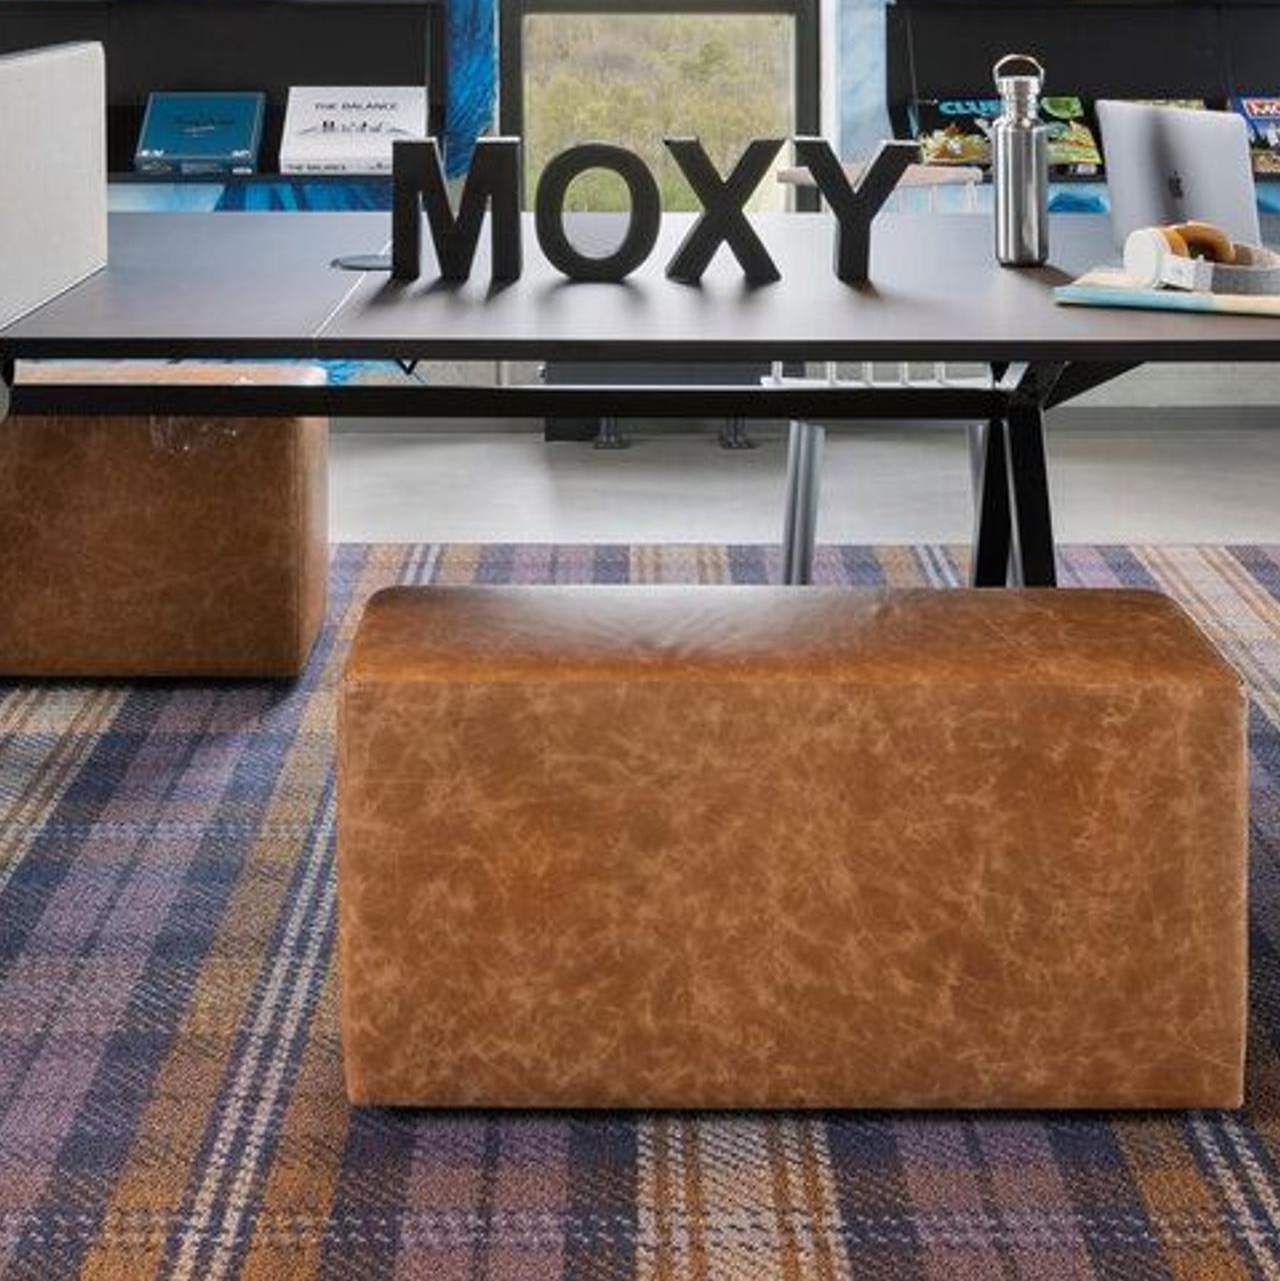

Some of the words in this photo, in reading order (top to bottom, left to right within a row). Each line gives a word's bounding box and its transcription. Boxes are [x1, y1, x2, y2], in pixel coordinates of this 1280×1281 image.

[314, 102, 336, 111] THE
[341, 102, 397, 111] BALANCE
[392, 137, 920, 283] MOXY
